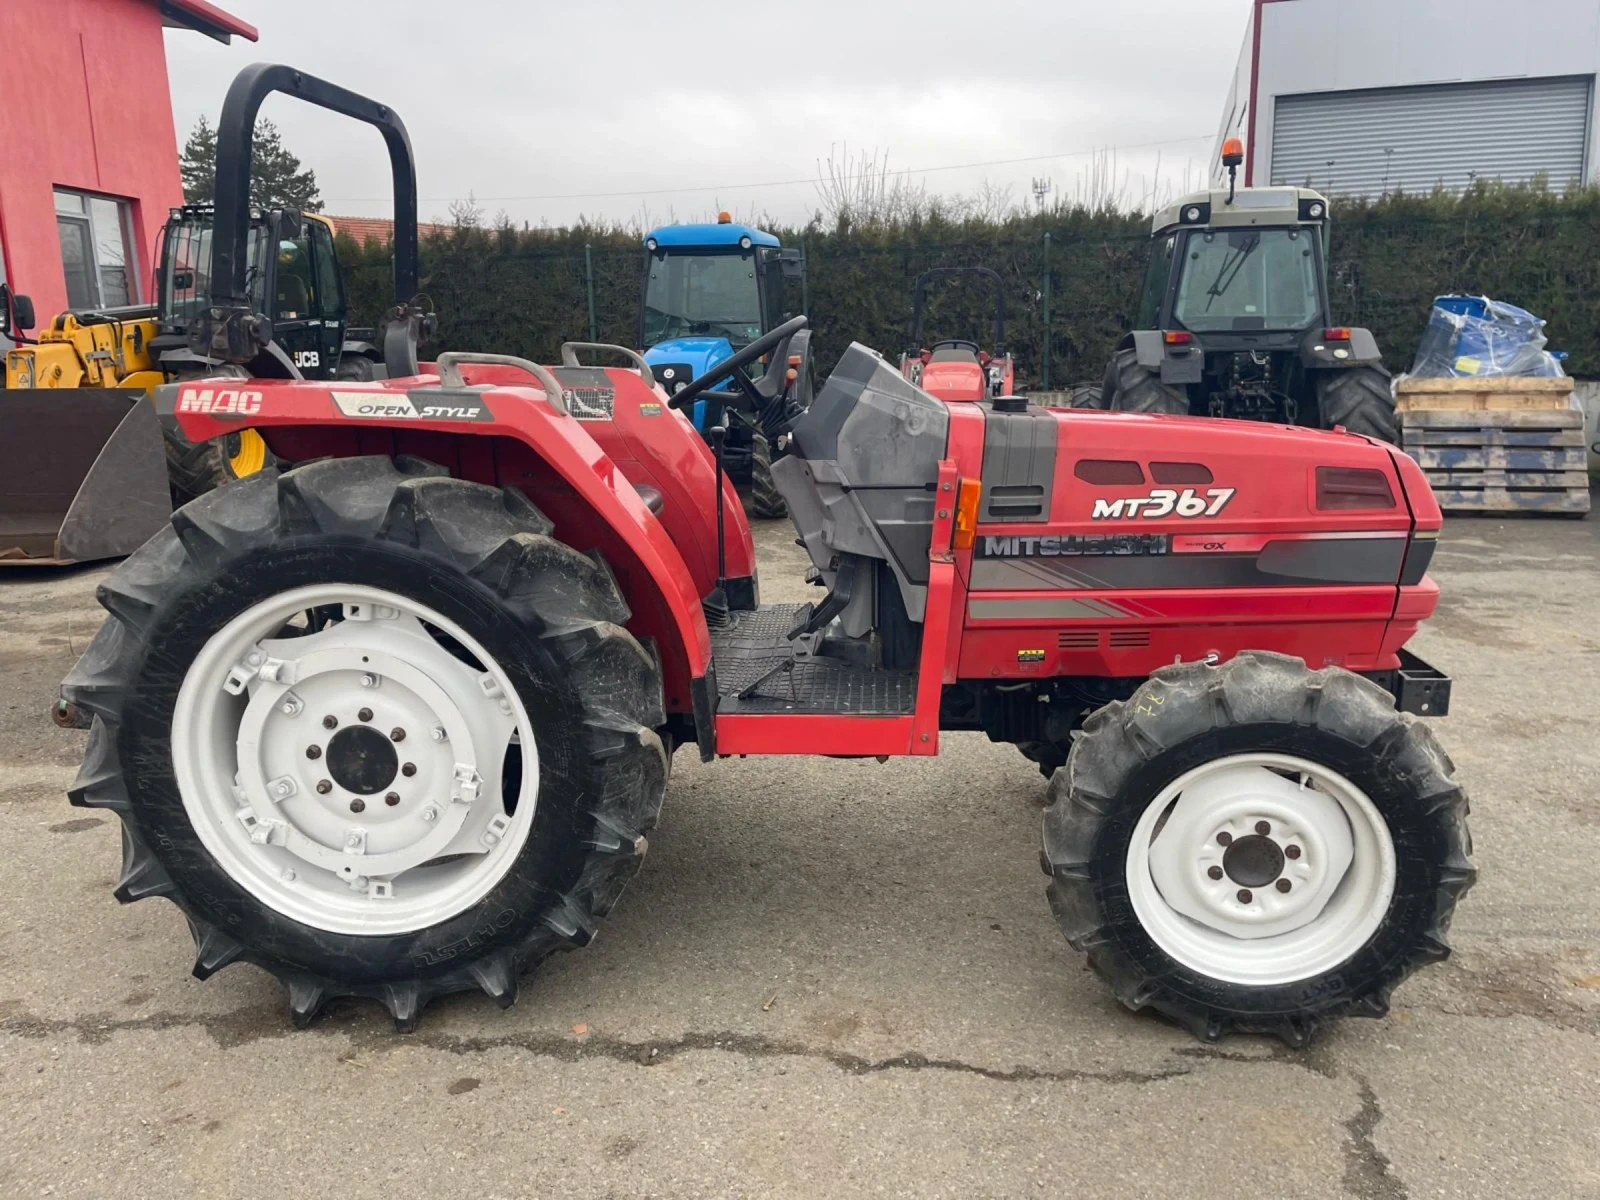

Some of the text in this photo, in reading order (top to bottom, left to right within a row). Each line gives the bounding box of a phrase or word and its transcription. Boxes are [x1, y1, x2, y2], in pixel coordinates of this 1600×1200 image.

[294, 351, 320, 368] JCB
[179, 389, 263, 414] MAC
[358, 405, 480, 418] OPEN STYLE
[1091, 488, 1236, 519] MT367
[985, 533, 1168, 556] MITSUBISHI
[1203, 541, 1227, 551] GX
